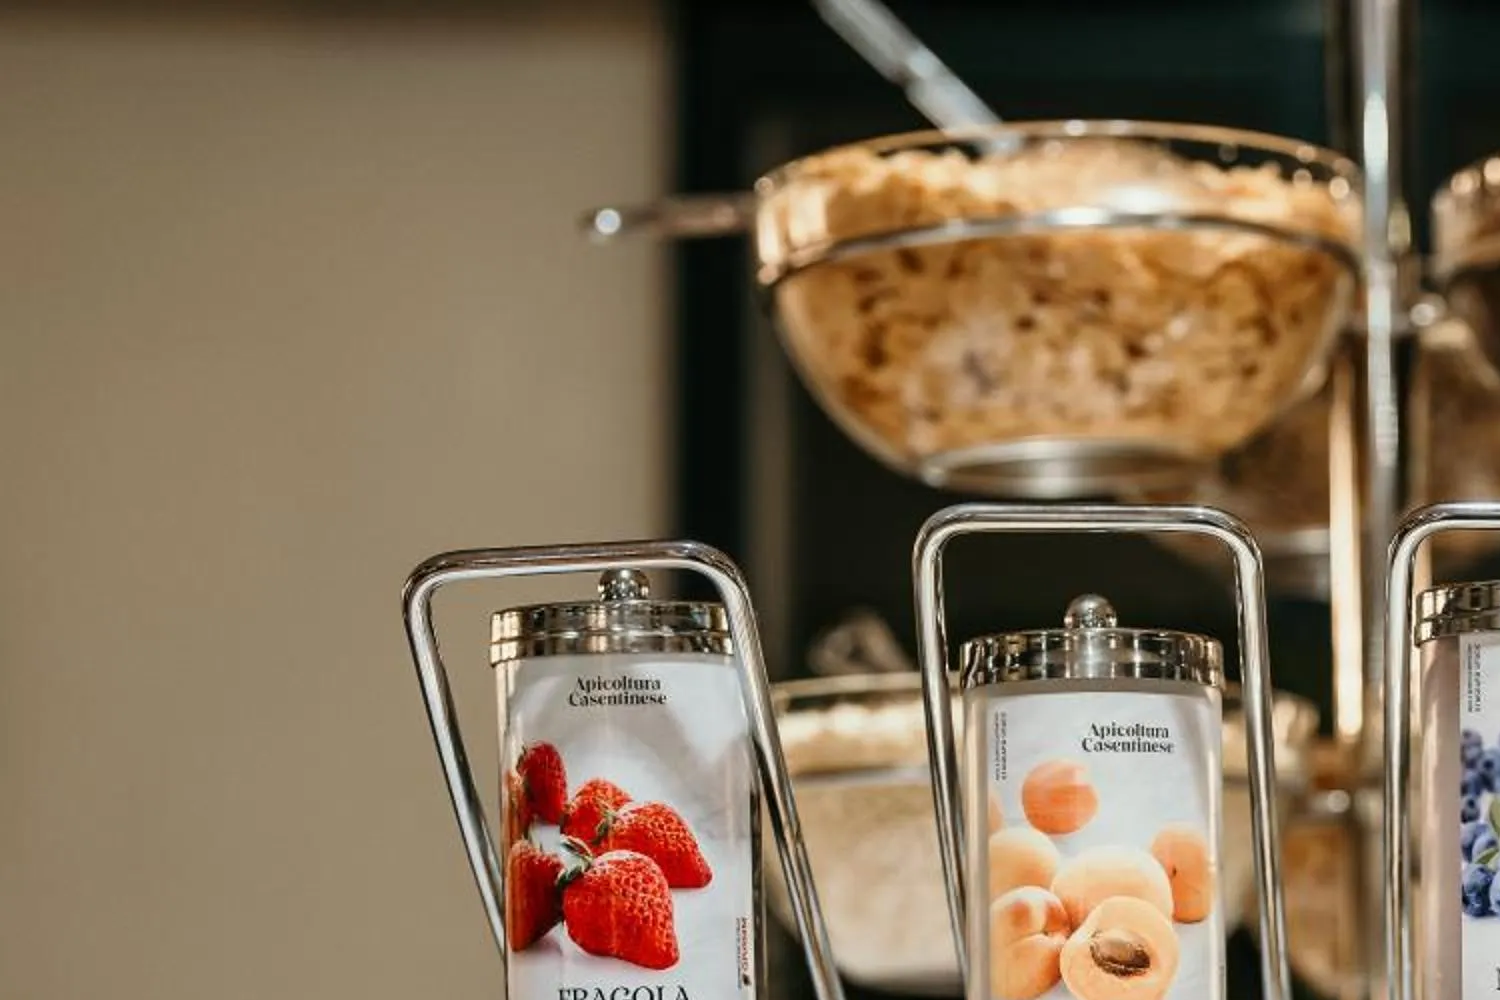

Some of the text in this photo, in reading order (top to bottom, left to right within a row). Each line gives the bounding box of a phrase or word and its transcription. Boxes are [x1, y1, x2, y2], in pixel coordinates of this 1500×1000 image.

[576, 676, 661, 692] Apicoltura
[568, 691, 667, 707] Casentinese
[1089, 723, 1169, 739] Apicoltura
[1081, 737, 1174, 754] Casentinese
